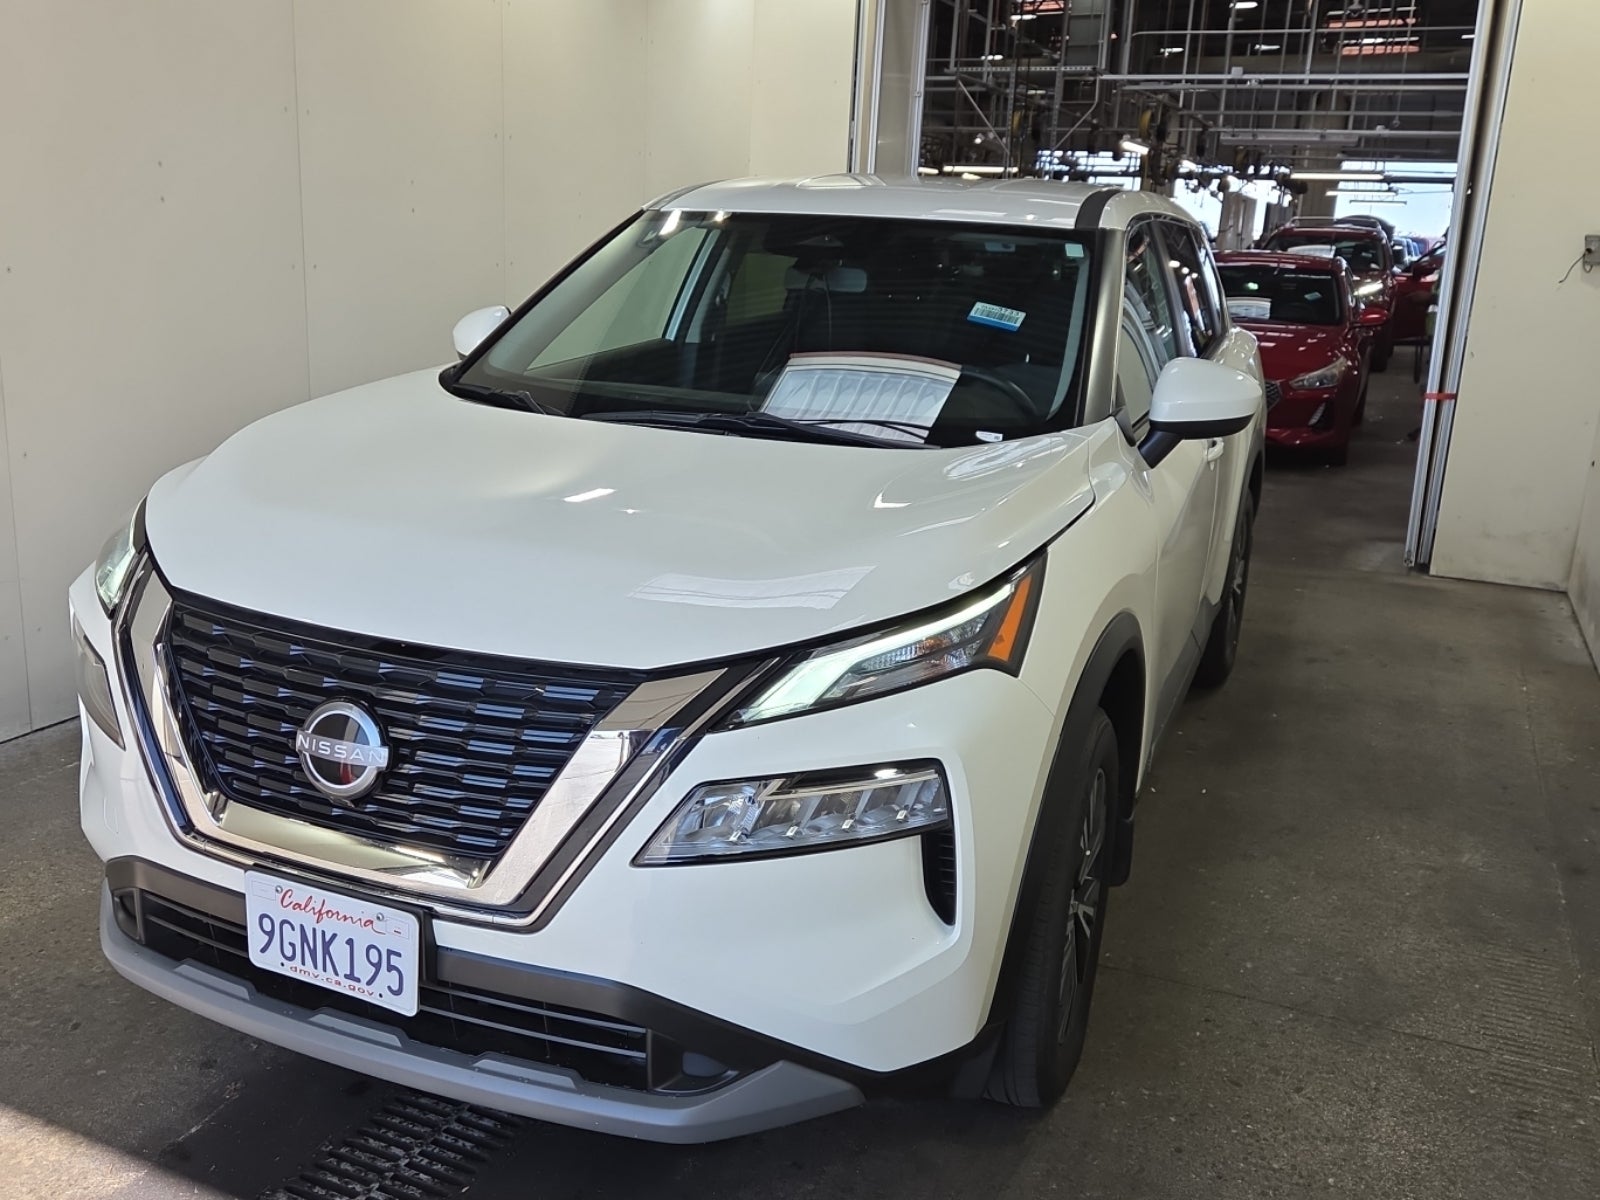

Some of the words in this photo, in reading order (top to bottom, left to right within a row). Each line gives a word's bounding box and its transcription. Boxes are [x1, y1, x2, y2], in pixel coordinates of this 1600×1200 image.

[297, 734, 385, 763] NISSAN
[280, 888, 386, 935] California
[258, 913, 404, 997] 9GNK195
[290, 965, 375, 997] dmv.ca.gov
